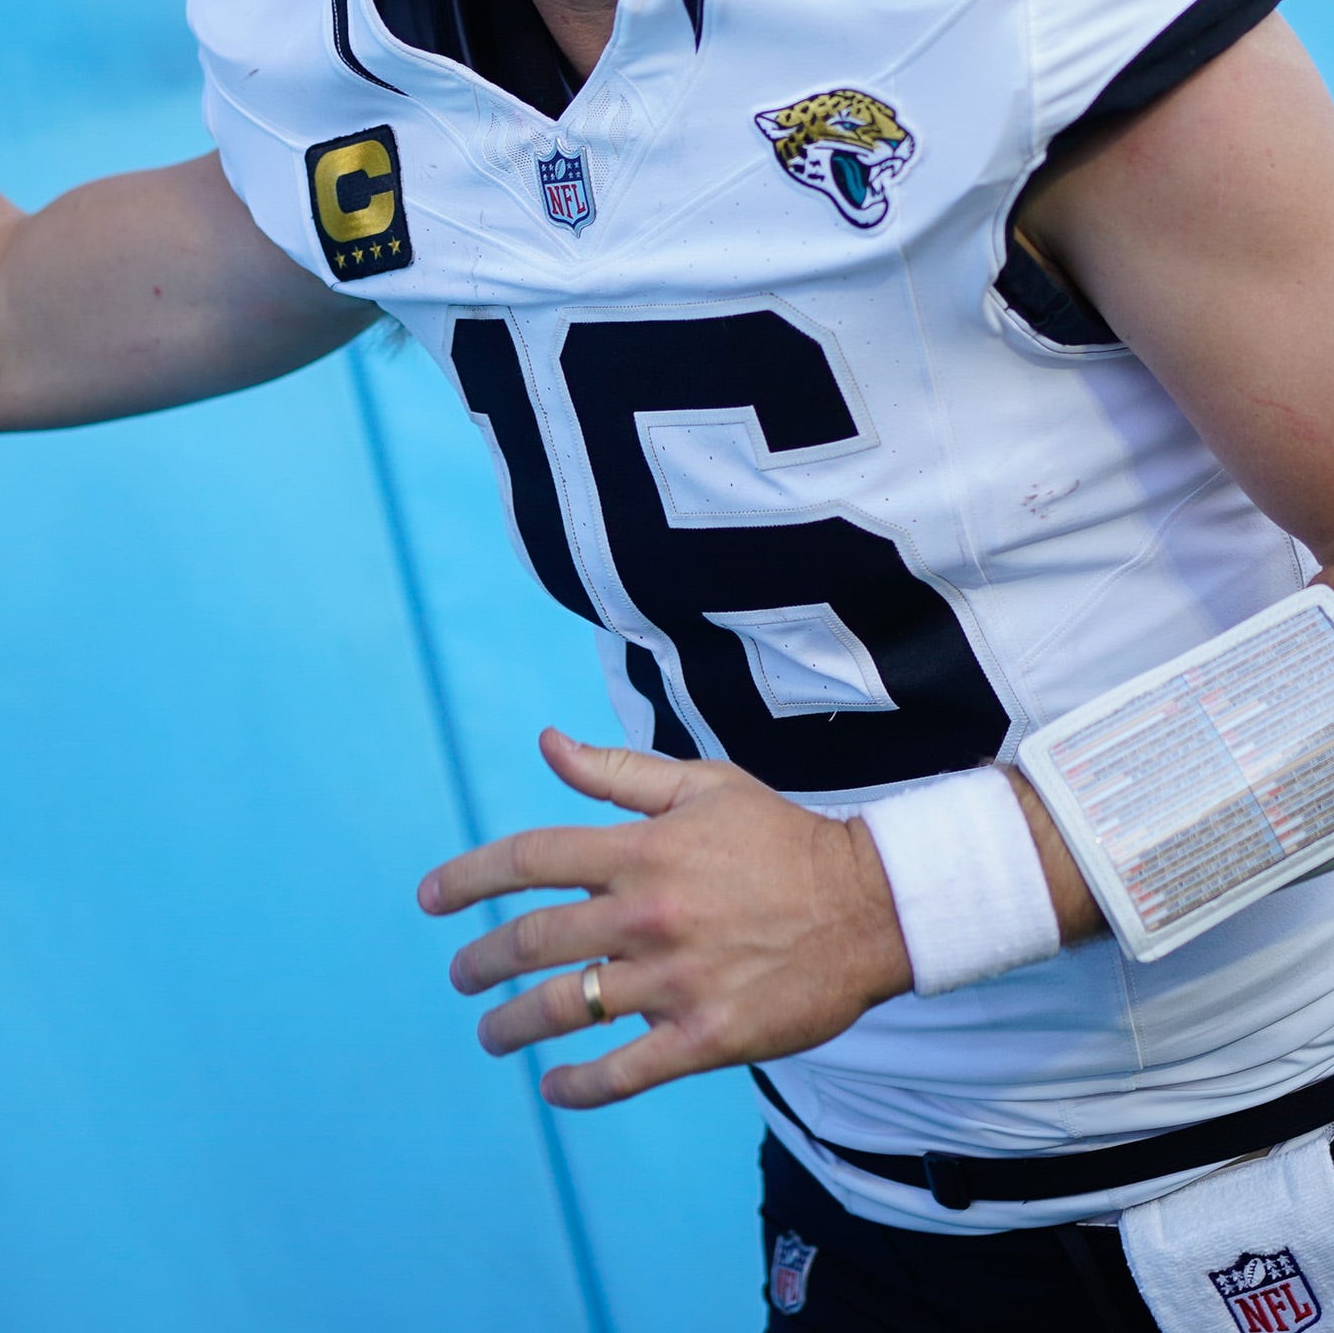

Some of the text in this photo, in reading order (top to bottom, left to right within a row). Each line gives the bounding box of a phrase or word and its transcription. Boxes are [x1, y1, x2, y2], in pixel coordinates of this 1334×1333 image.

[314, 139, 396, 243] C
[546, 183, 587, 219] NFL
[450, 309, 1013, 793] 16
[1233, 1282, 1314, 1333] NFL
